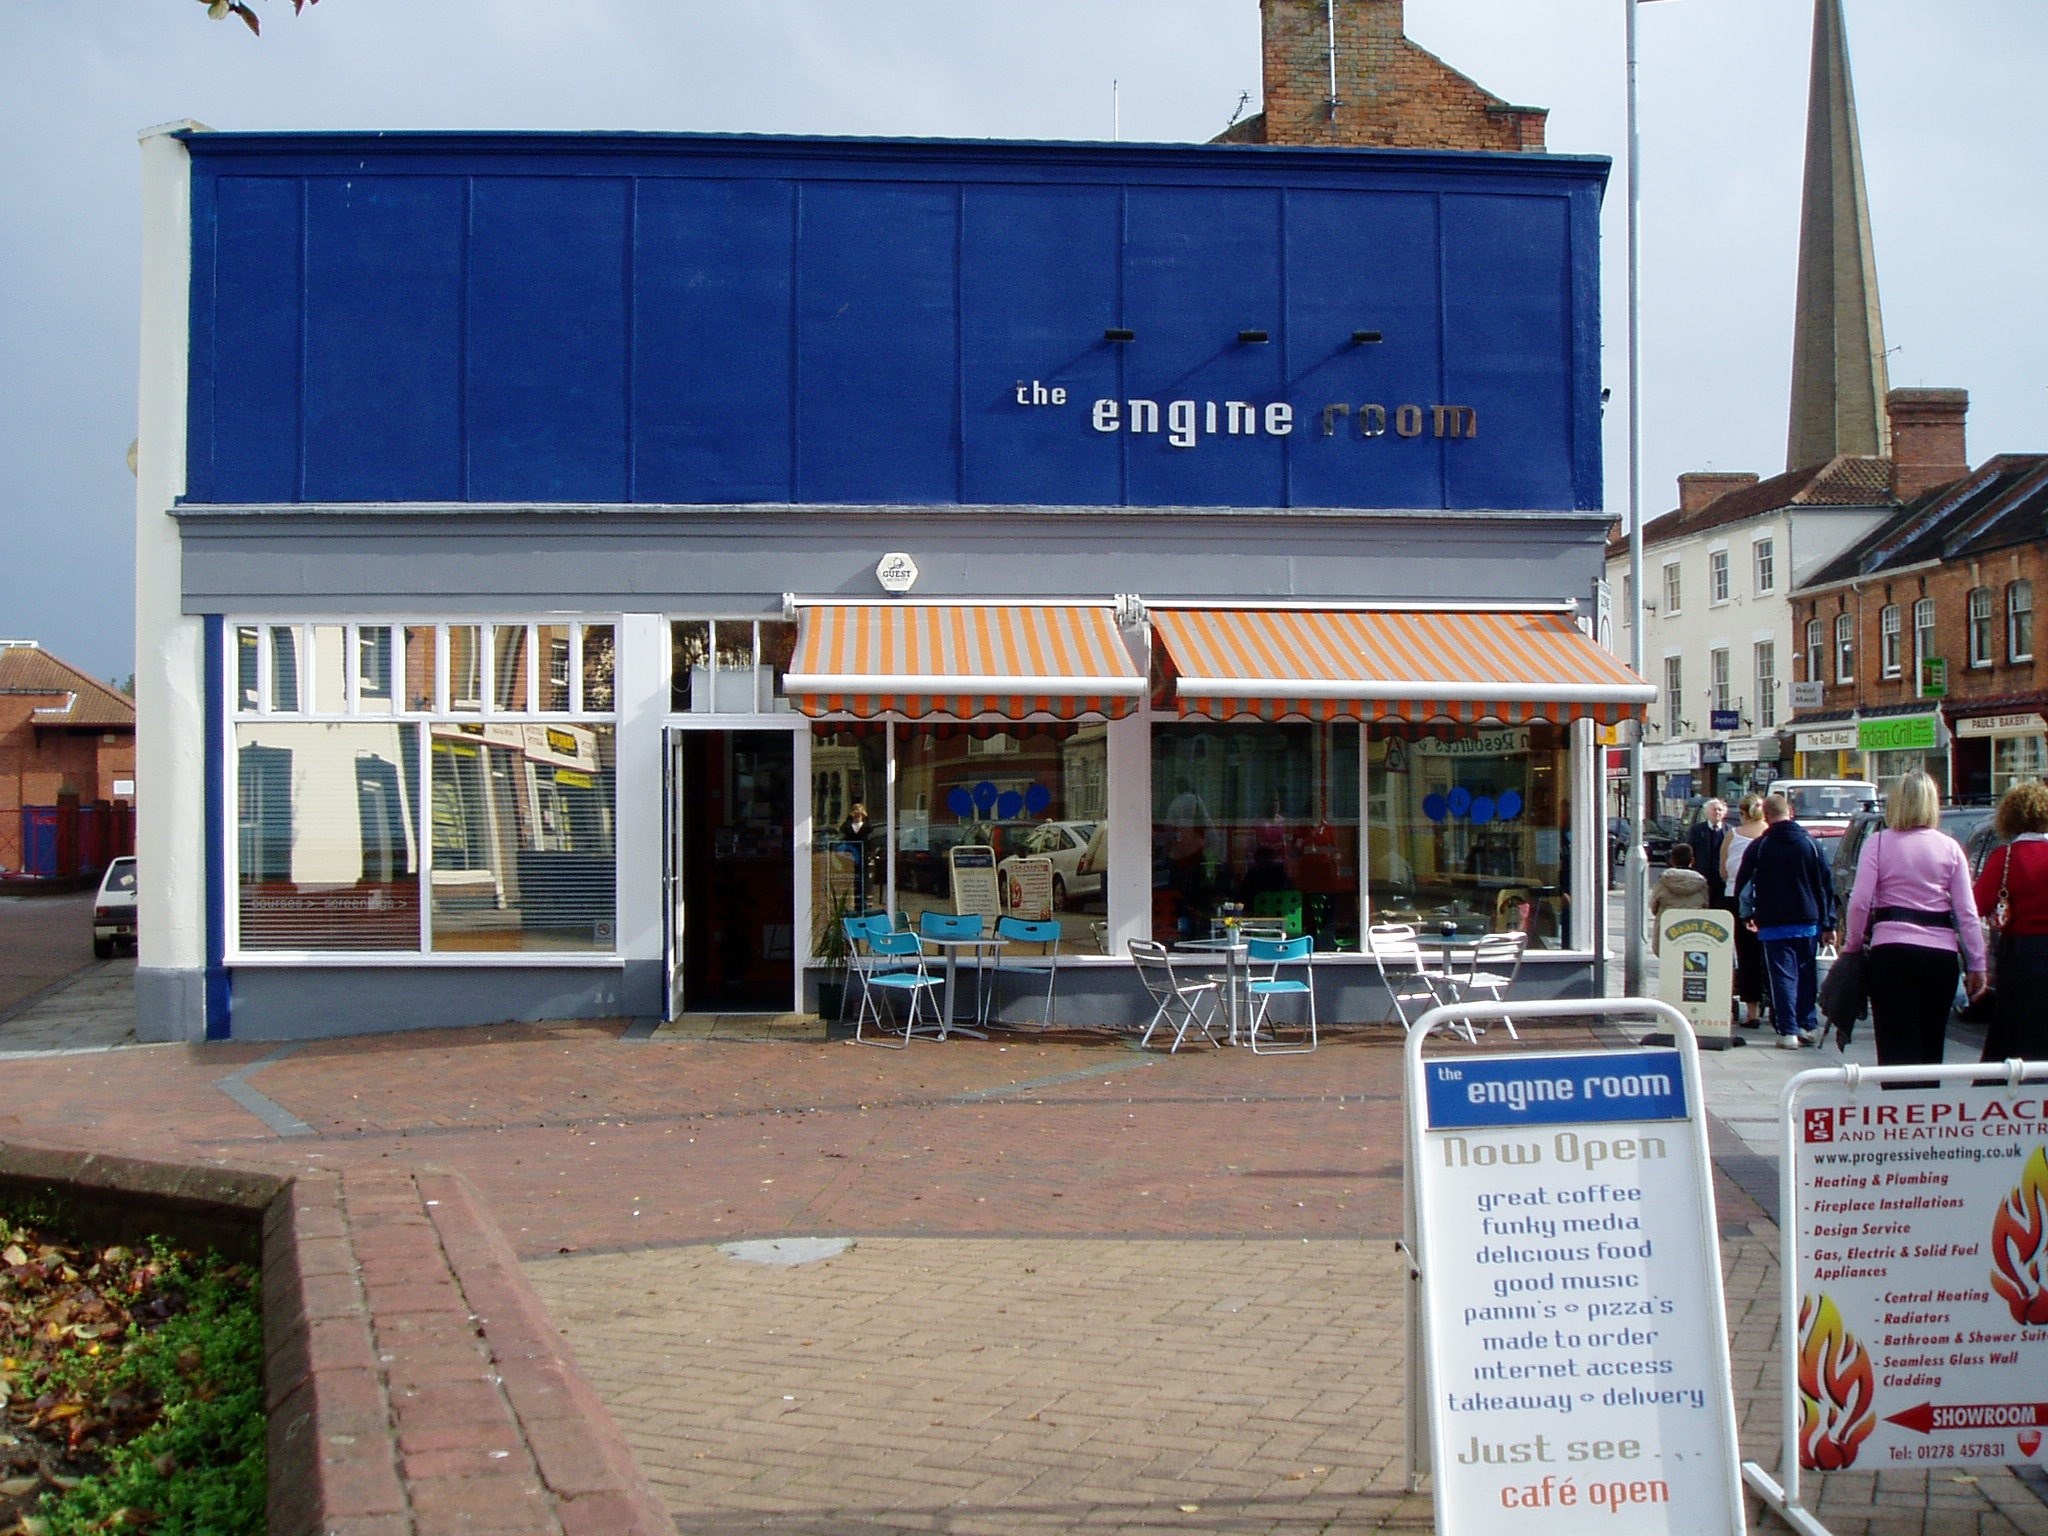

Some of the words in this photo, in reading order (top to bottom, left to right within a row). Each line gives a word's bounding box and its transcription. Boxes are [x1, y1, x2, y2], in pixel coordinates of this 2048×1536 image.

[1017, 380, 1066, 405] the
[1092, 399, 1293, 447] engine
[1323, 403, 1477, 438] room
[882, 570, 911, 578] GUEST
[1972, 718, 1995, 730] PAULS
[1999, 715, 2031, 728] BAKERY
[1808, 735, 1818, 746] The
[1859, 726, 1890, 747] Indian
[1892, 722, 1912, 746] Grill
[1669, 923, 1698, 938] Bean
[1703, 922, 1723, 938] Fair
[1438, 1066, 1462, 1082] the
[1467, 1078, 1574, 1112] engine
[1584, 1074, 1670, 1098] room
[1840, 1130, 1876, 1142] AND
[1884, 1124, 1974, 1140] HEATING
[1443, 1136, 1541, 1168] Now
[1554, 1132, 1666, 1170] Open
[1814, 1143, 2022, 1165] www.progressiveheating.co.uk
[1814, 1174, 1867, 1189] Heating
[1872, 1174, 1882, 1186] &
[1885, 1172, 1949, 1186] Plumbing
[1477, 1187, 1550, 1212] great
[1557, 1184, 1642, 1204] coffee
[1814, 1199, 1876, 1214] Fireplace
[1880, 1196, 1964, 1210] Installations
[1483, 1215, 1556, 1238] funky
[1563, 1213, 1640, 1232] media
[1814, 1225, 1858, 1238] Design
[1862, 1222, 1911, 1235] Service
[1476, 1243, 1590, 1265] delicious
[1596, 1240, 1653, 1260] food
[1814, 1250, 1842, 1262] Gas,
[1847, 1246, 1896, 1260] Electric
[1900, 1246, 1909, 1258] &
[1914, 1244, 1948, 1258] Solid
[1952, 1244, 1979, 1256] Fuel
[1814, 1266, 1888, 1282] Appliances
[1494, 1273, 1554, 1297] good
[1562, 1272, 1640, 1290] music
[1884, 1290, 1933, 1304] Central
[1936, 1289, 1990, 1303] Heating
[1464, 1300, 1556, 1326] panini's
[1588, 1296, 1674, 1320] pizza's
[1884, 1312, 1950, 1325] Radiators
[1483, 1330, 1548, 1350] made
[1555, 1330, 1580, 1348] to
[1588, 1327, 1659, 1346] order
[1884, 1334, 1950, 1346] Bathroom
[1954, 1332, 1964, 1344] &
[1968, 1331, 2016, 1344] Shower
[2020, 1330, 2048, 1342] Suit
[1884, 1354, 1945, 1368] Seamless
[1950, 1353, 1986, 1366] Glass
[1989, 1351, 2018, 1364] Wall
[1474, 1359, 1580, 1380] internet
[1587, 1360, 1673, 1376] access
[1883, 1374, 1942, 1388] Cladding
[1448, 1391, 1572, 1413] takeaway
[1602, 1386, 1705, 1410] delivery
[1932, 1406, 2036, 1427] SHOWROOM
[1457, 1434, 1555, 1465] Just
[1567, 1438, 1640, 1460] see
[1889, 1446, 1912, 1460] Tel:
[1917, 1445, 1955, 1459] 01278
[1960, 1444, 2005, 1458] 457831
[1501, 1476, 1577, 1508] café
[1589, 1478, 1669, 1512] open
